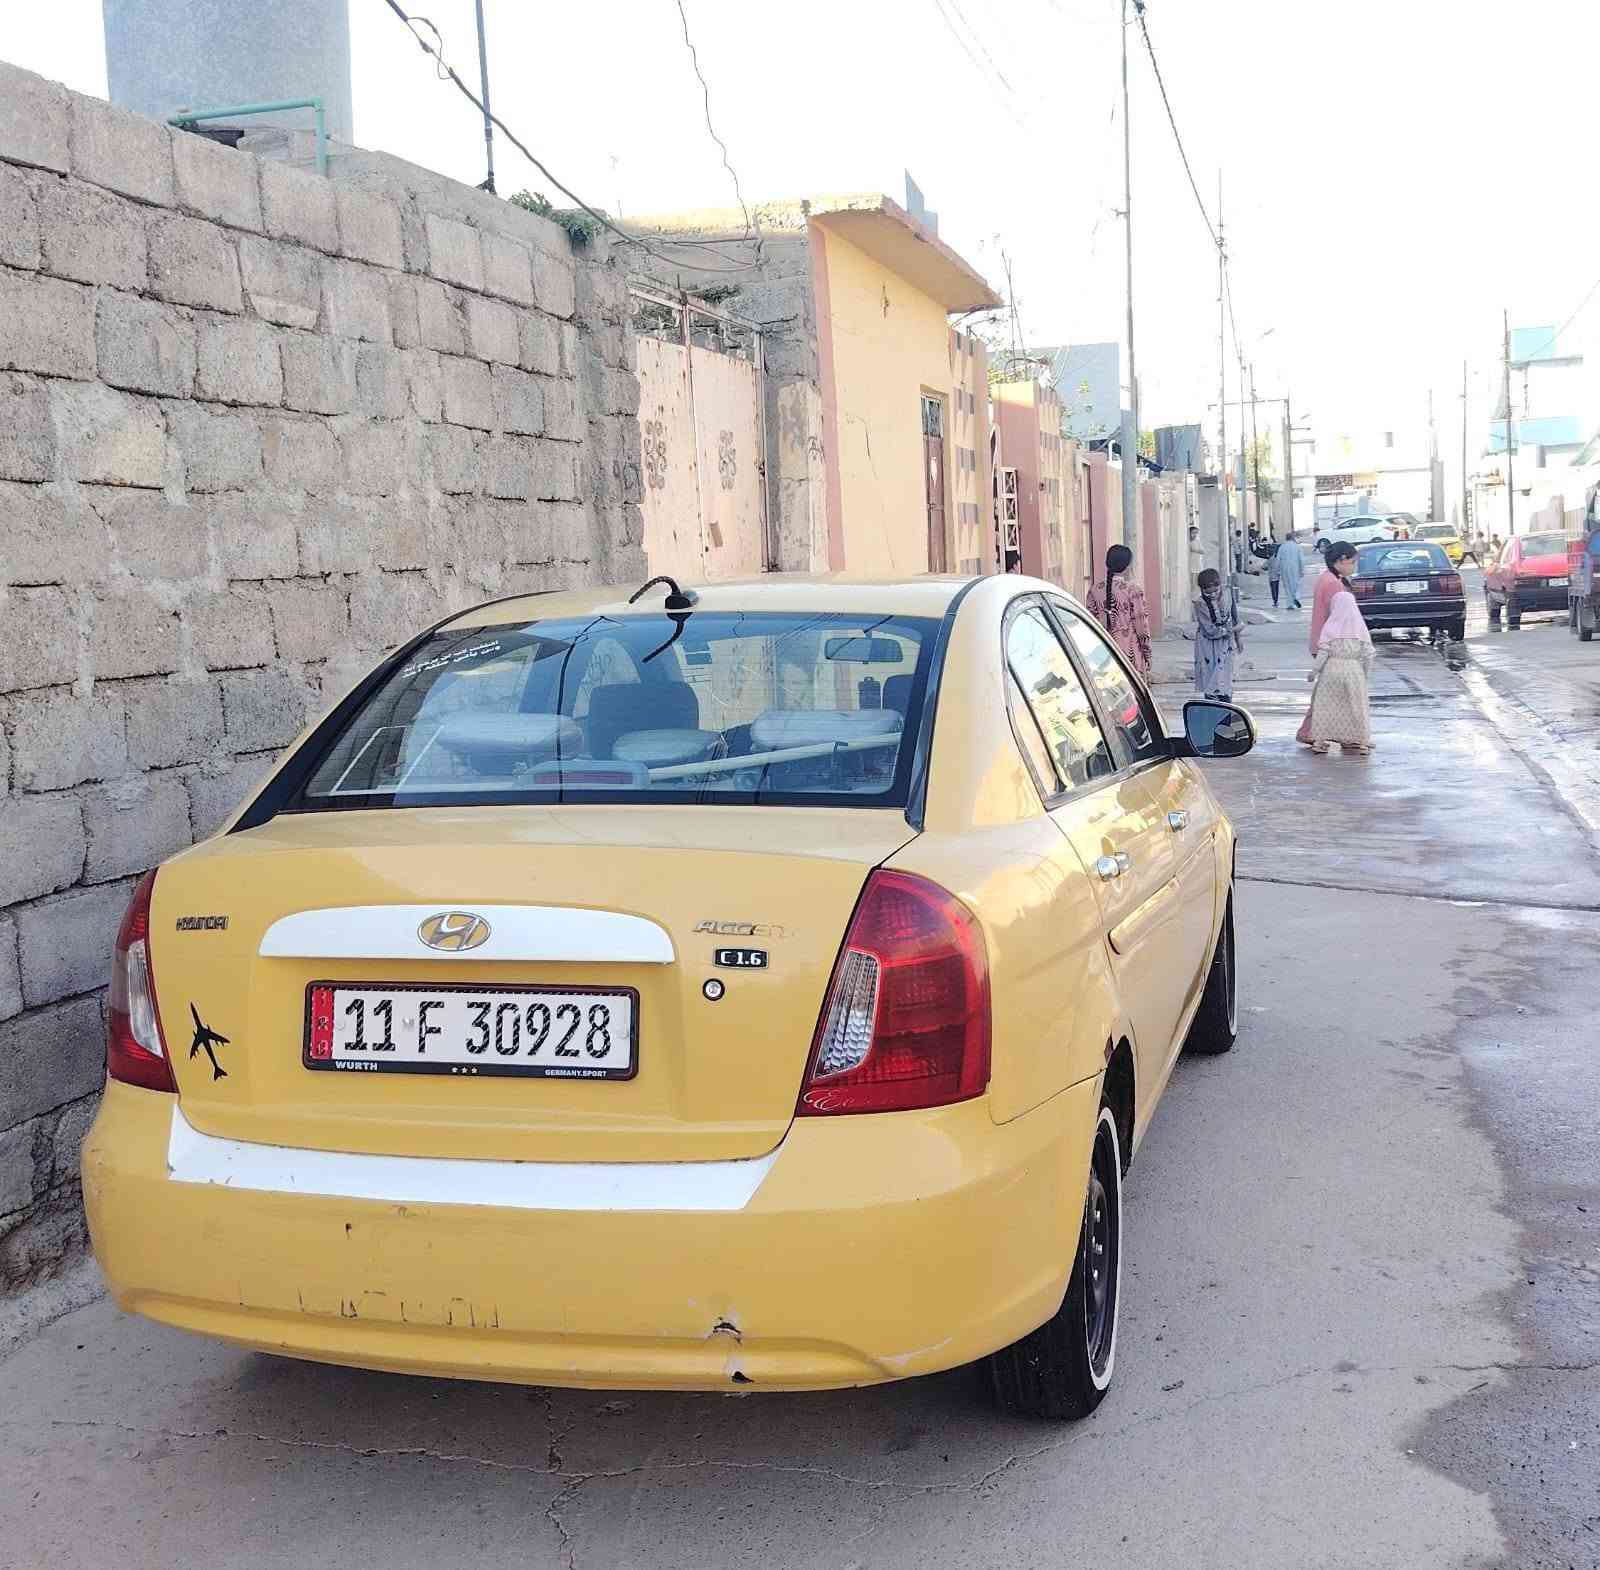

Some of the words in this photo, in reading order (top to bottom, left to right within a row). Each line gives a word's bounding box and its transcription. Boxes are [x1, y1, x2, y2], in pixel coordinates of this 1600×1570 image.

[736, 951, 762, 966] 1.6
[344, 998, 396, 1052] 11
[417, 1000, 445, 1053] F
[465, 1001, 612, 1059] 30928
[335, 1060, 378, 1072] WURTH
